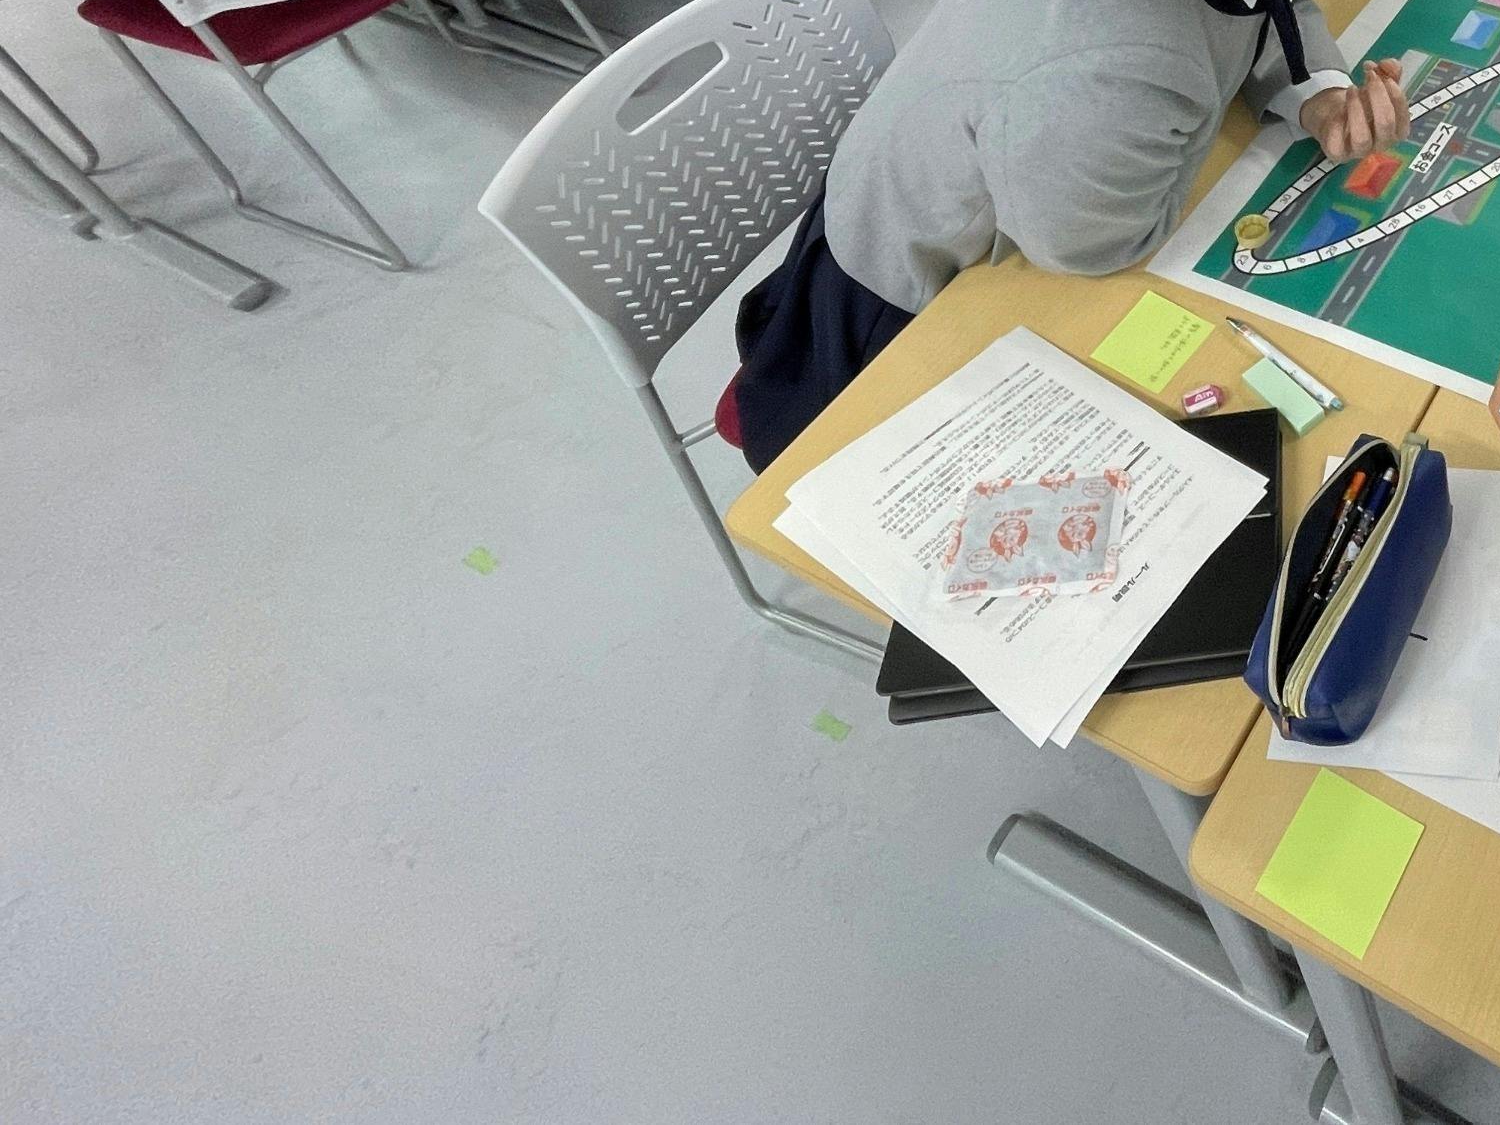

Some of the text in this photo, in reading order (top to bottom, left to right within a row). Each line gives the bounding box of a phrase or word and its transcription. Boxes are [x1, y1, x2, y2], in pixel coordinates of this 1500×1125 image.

[1414, 125, 1453, 172] お金コース
[1111, 562, 1150, 604] ルール説明
